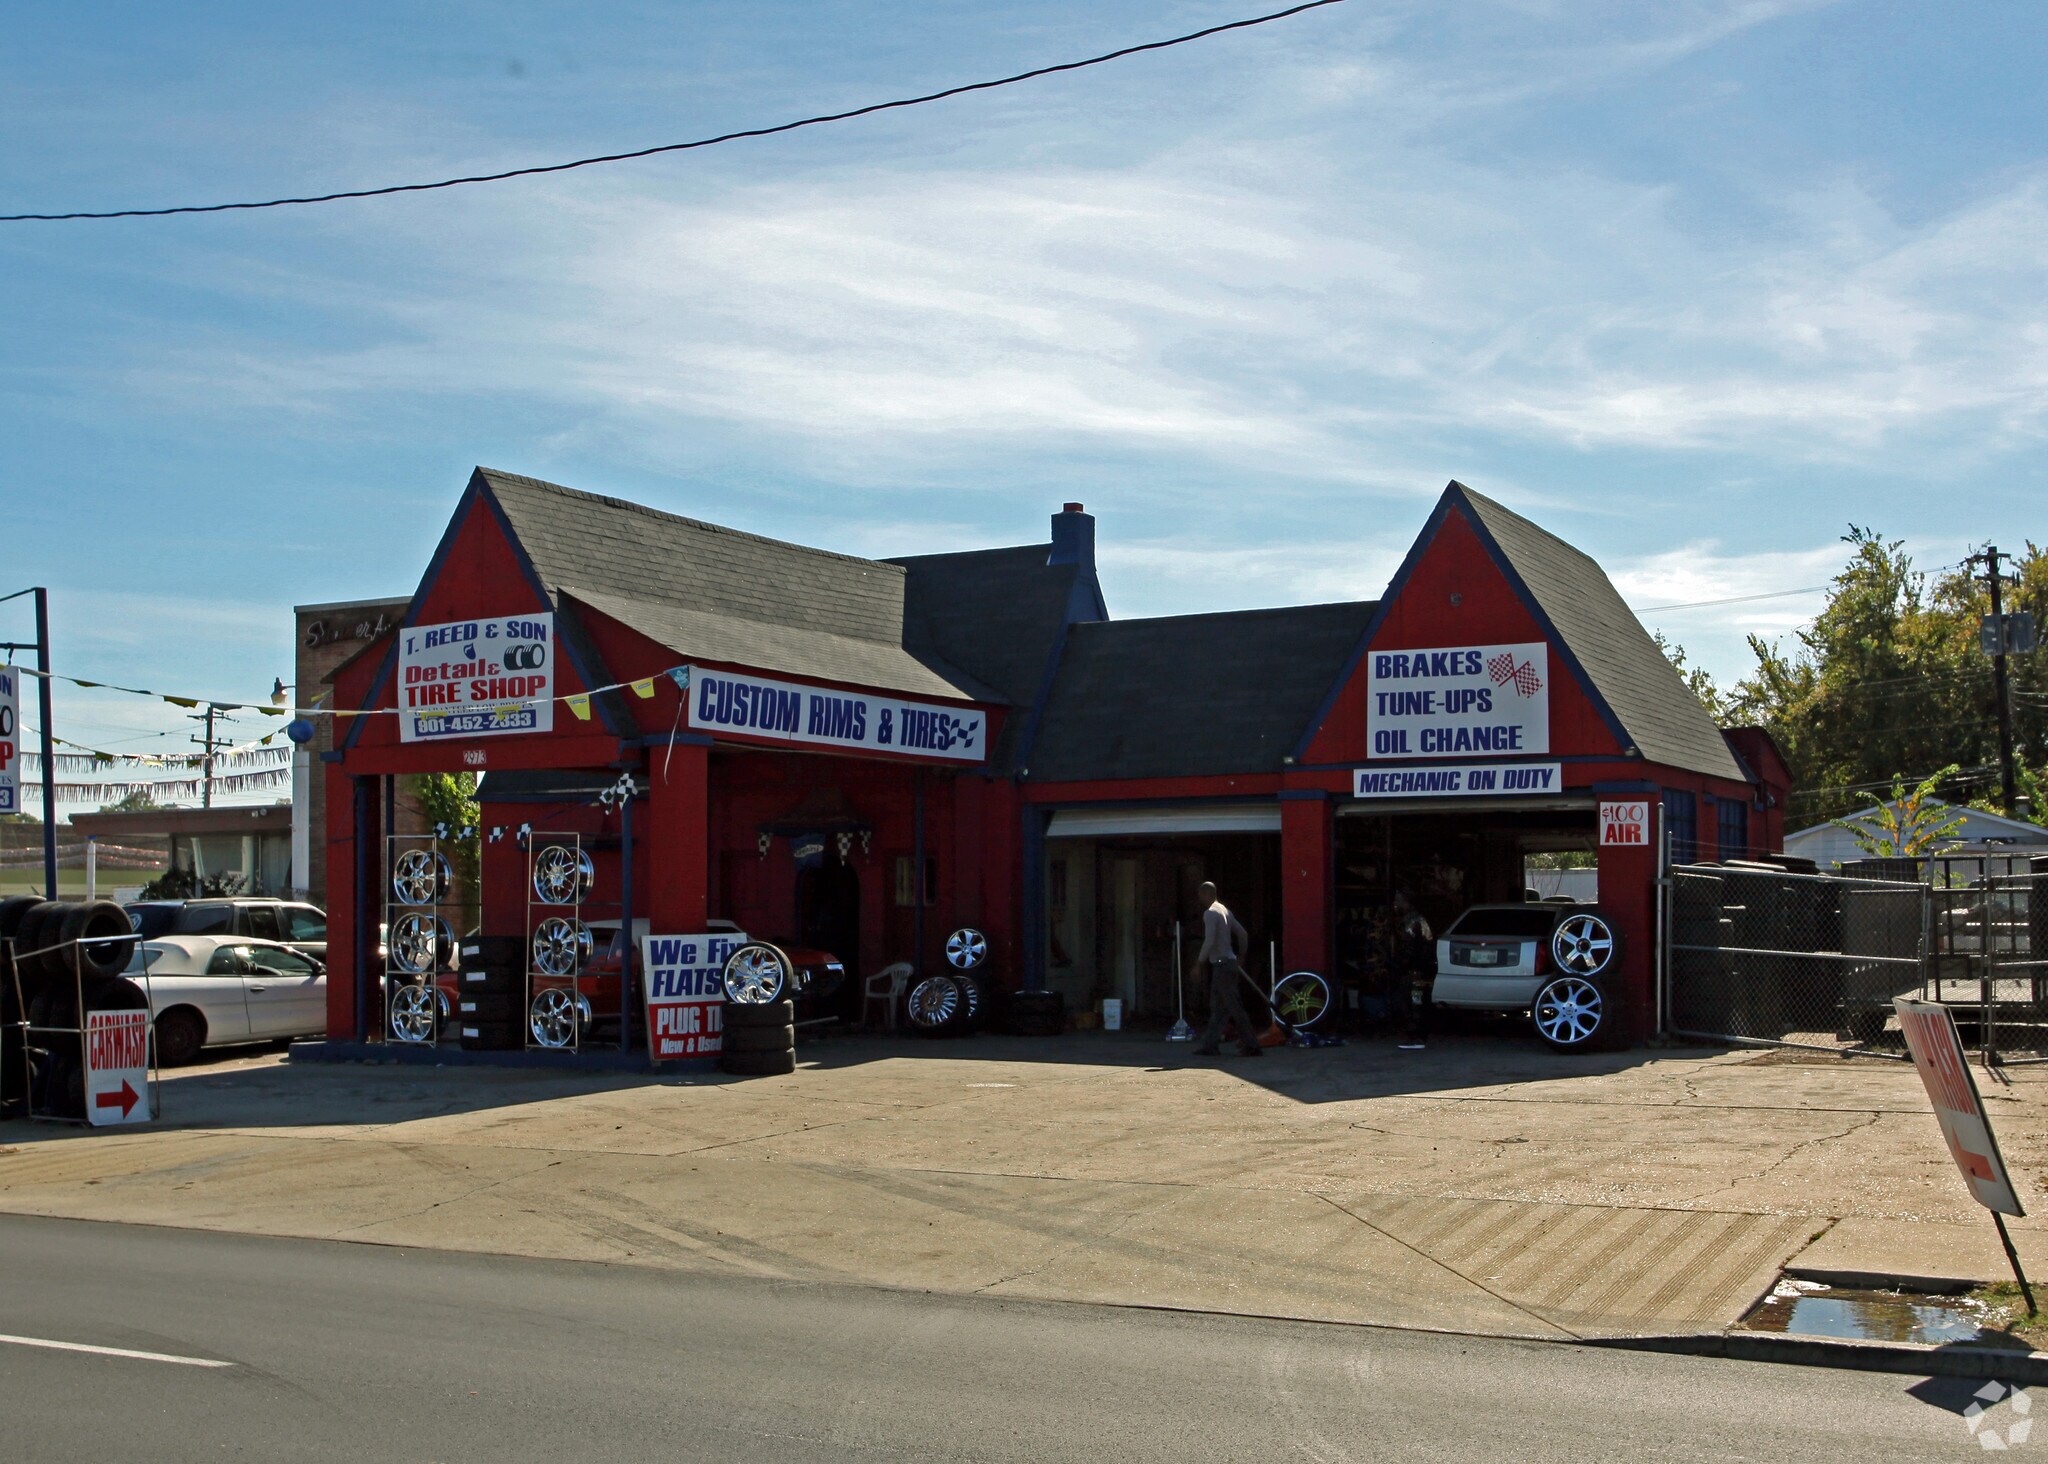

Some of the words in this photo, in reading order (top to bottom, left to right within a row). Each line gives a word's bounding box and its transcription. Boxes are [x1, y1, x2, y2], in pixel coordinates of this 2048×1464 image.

[406, 636, 419, 656] T.
[425, 622, 478, 649] REED
[485, 623, 499, 639] &
[506, 620, 547, 642] SON
[405, 658, 486, 684] Detail
[1375, 650, 1483, 679] BRAKES
[404, 681, 462, 708] TIRE
[470, 675, 546, 701] SHOP
[1376, 687, 1493, 716] TUNE-UPS
[418, 712, 532, 733] 901-452-2333
[697, 677, 801, 733] CUSTOM
[807, 694, 867, 741] RIMS
[877, 708, 893, 744] &
[900, 708, 951, 751] TIRES
[1375, 730, 1413, 754] OIL
[1420, 725, 1523, 753] CHANGE
[1359, 770, 1462, 793] MECHANIC
[1467, 770, 1497, 791] ON
[1503, 768, 1554, 790] DUTY
[1605, 823, 1641, 843] AIR
[649, 939, 697, 965] We
[652, 967, 721, 997] FLATS
[656, 1006, 700, 1035] PLUG
[706, 1005, 723, 1032] TI
[90, 1013, 146, 1071] CARWASH
[660, 1038, 684, 1055] New
[686, 1037, 695, 1053] &
[698, 1036, 722, 1053] Used
